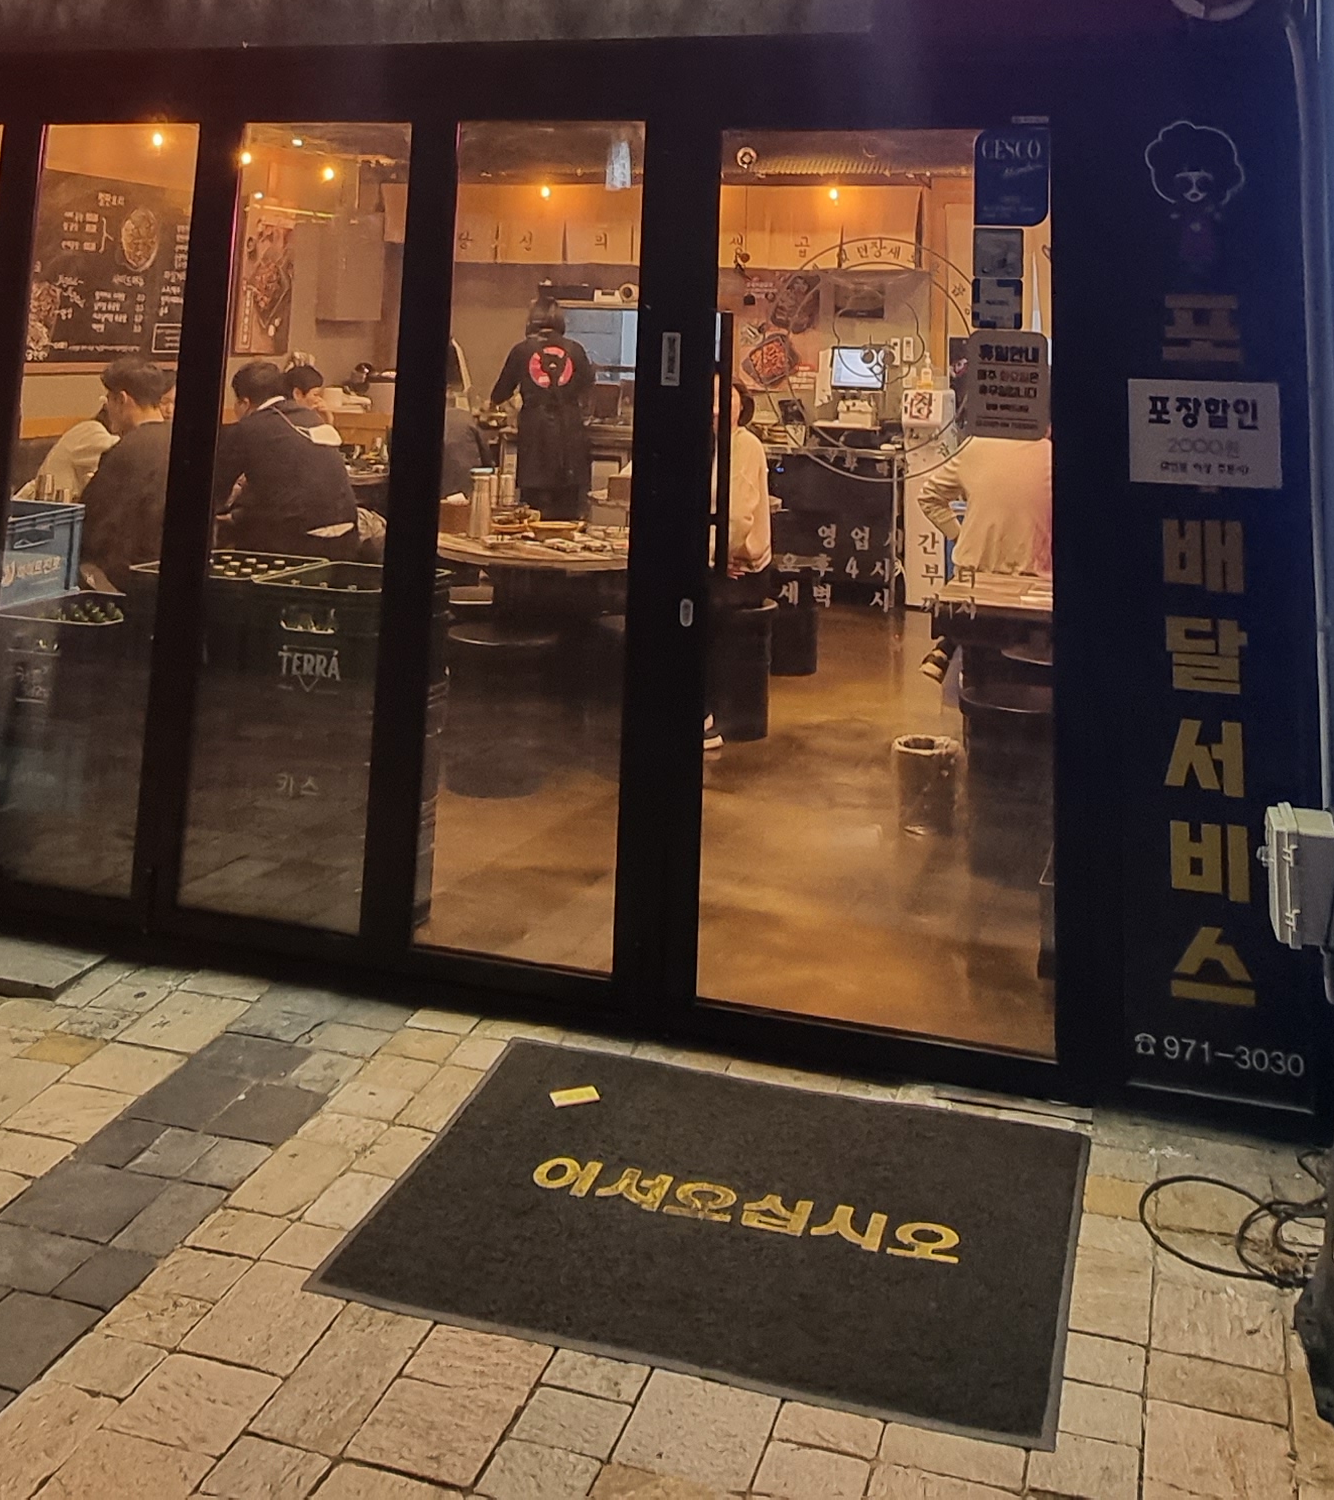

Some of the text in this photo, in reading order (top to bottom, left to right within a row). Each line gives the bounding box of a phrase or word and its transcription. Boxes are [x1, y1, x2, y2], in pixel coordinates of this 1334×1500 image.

[981, 138, 1041, 160] CESCO
[1147, 395, 1260, 431] 포장할인
[277, 649, 341, 682] TERRA
[1162, 1035, 1305, 1078] 971-3030
[531, 1155, 962, 1265] 어서오십시오
